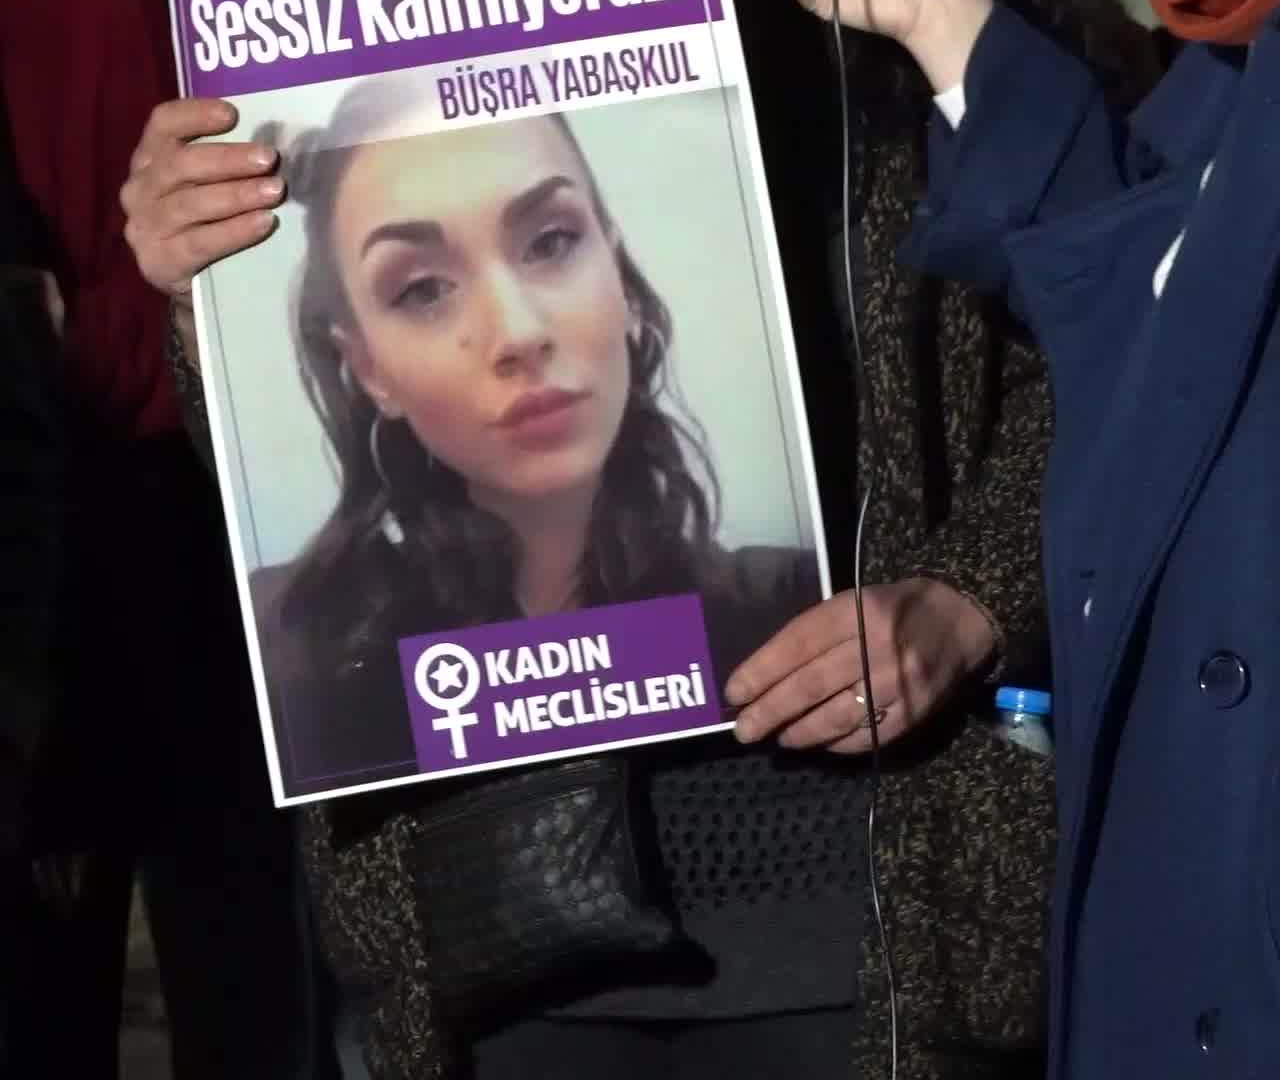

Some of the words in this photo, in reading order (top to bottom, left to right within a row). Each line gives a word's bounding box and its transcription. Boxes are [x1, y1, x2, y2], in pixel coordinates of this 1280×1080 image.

[437, 65, 541, 122] BÜŞRA
[541, 40, 700, 102] YABAŞKUL
[485, 634, 613, 688] KADIN
[494, 663, 707, 738] MECLİSLERİ
